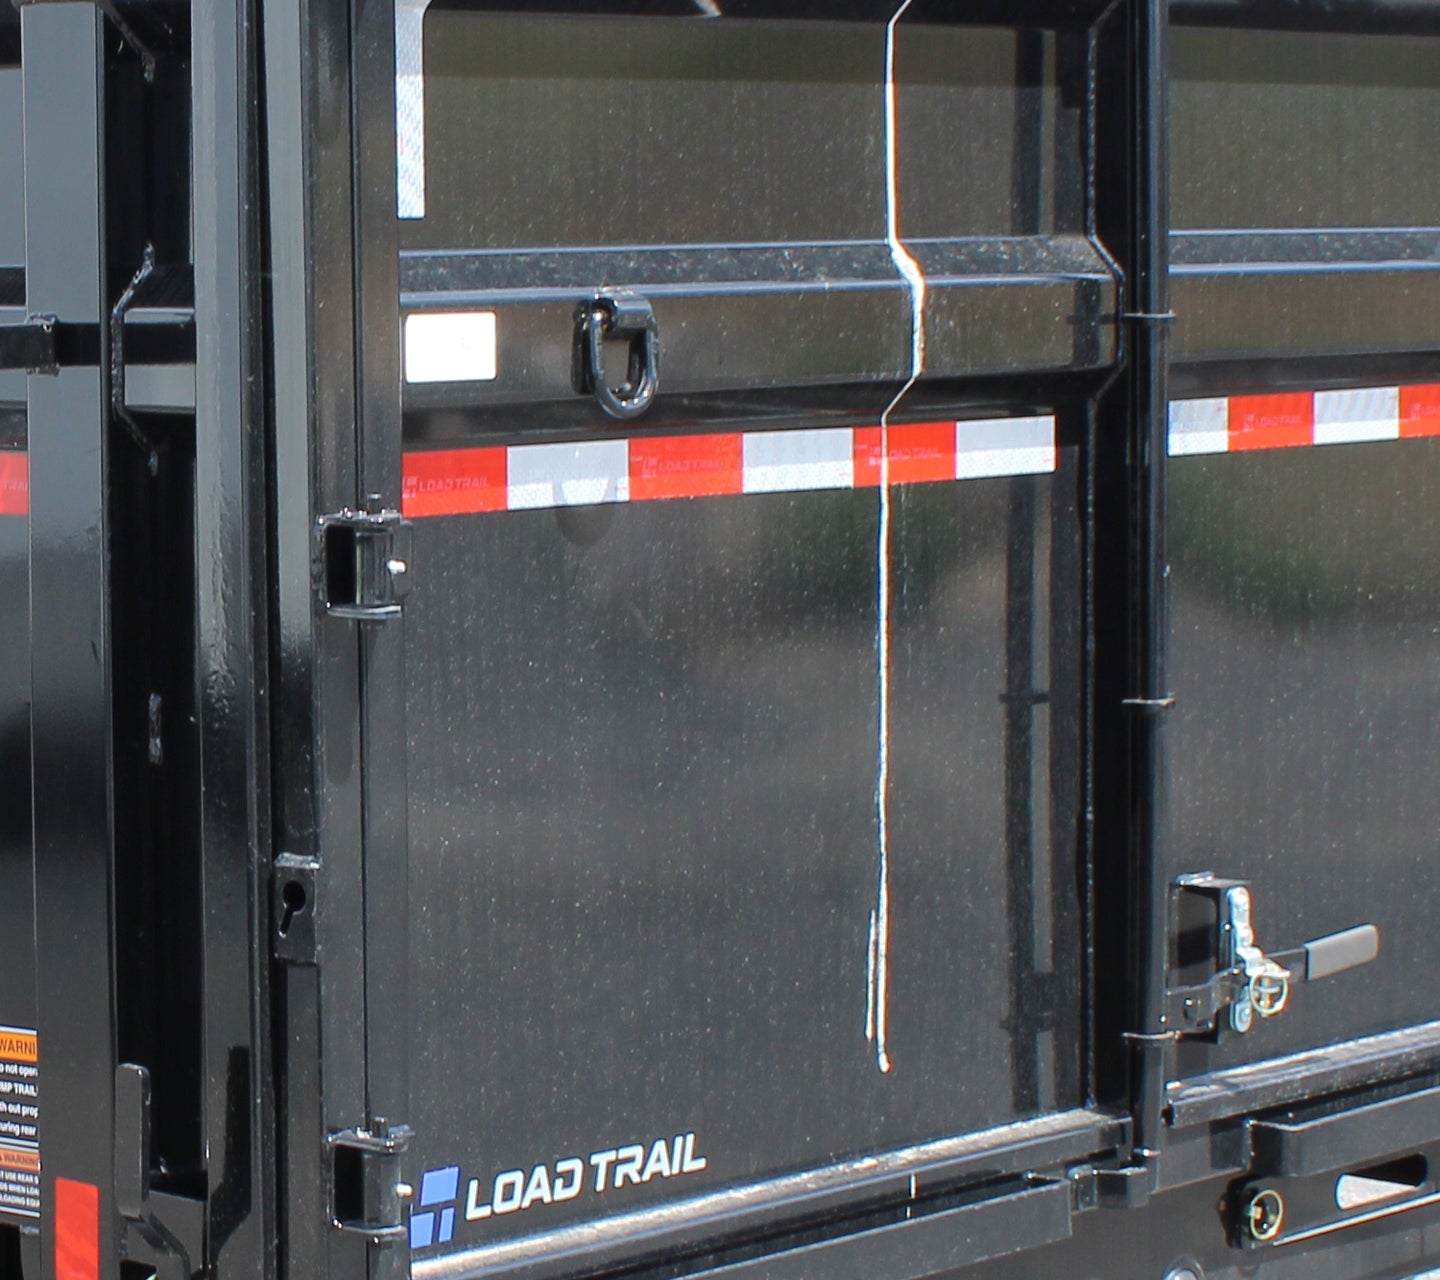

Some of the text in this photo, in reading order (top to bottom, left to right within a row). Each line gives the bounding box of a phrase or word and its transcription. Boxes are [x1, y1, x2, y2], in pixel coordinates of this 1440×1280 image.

[420, 476, 488, 491] LOAD TRAIL
[5, 1063, 18, 1075] not
[14, 1082, 38, 1097] TRAIL
[8, 1103, 21, 1115] out
[21, 1124, 36, 1136] rear
[465, 1132, 707, 1221] LOAD TRAIL
